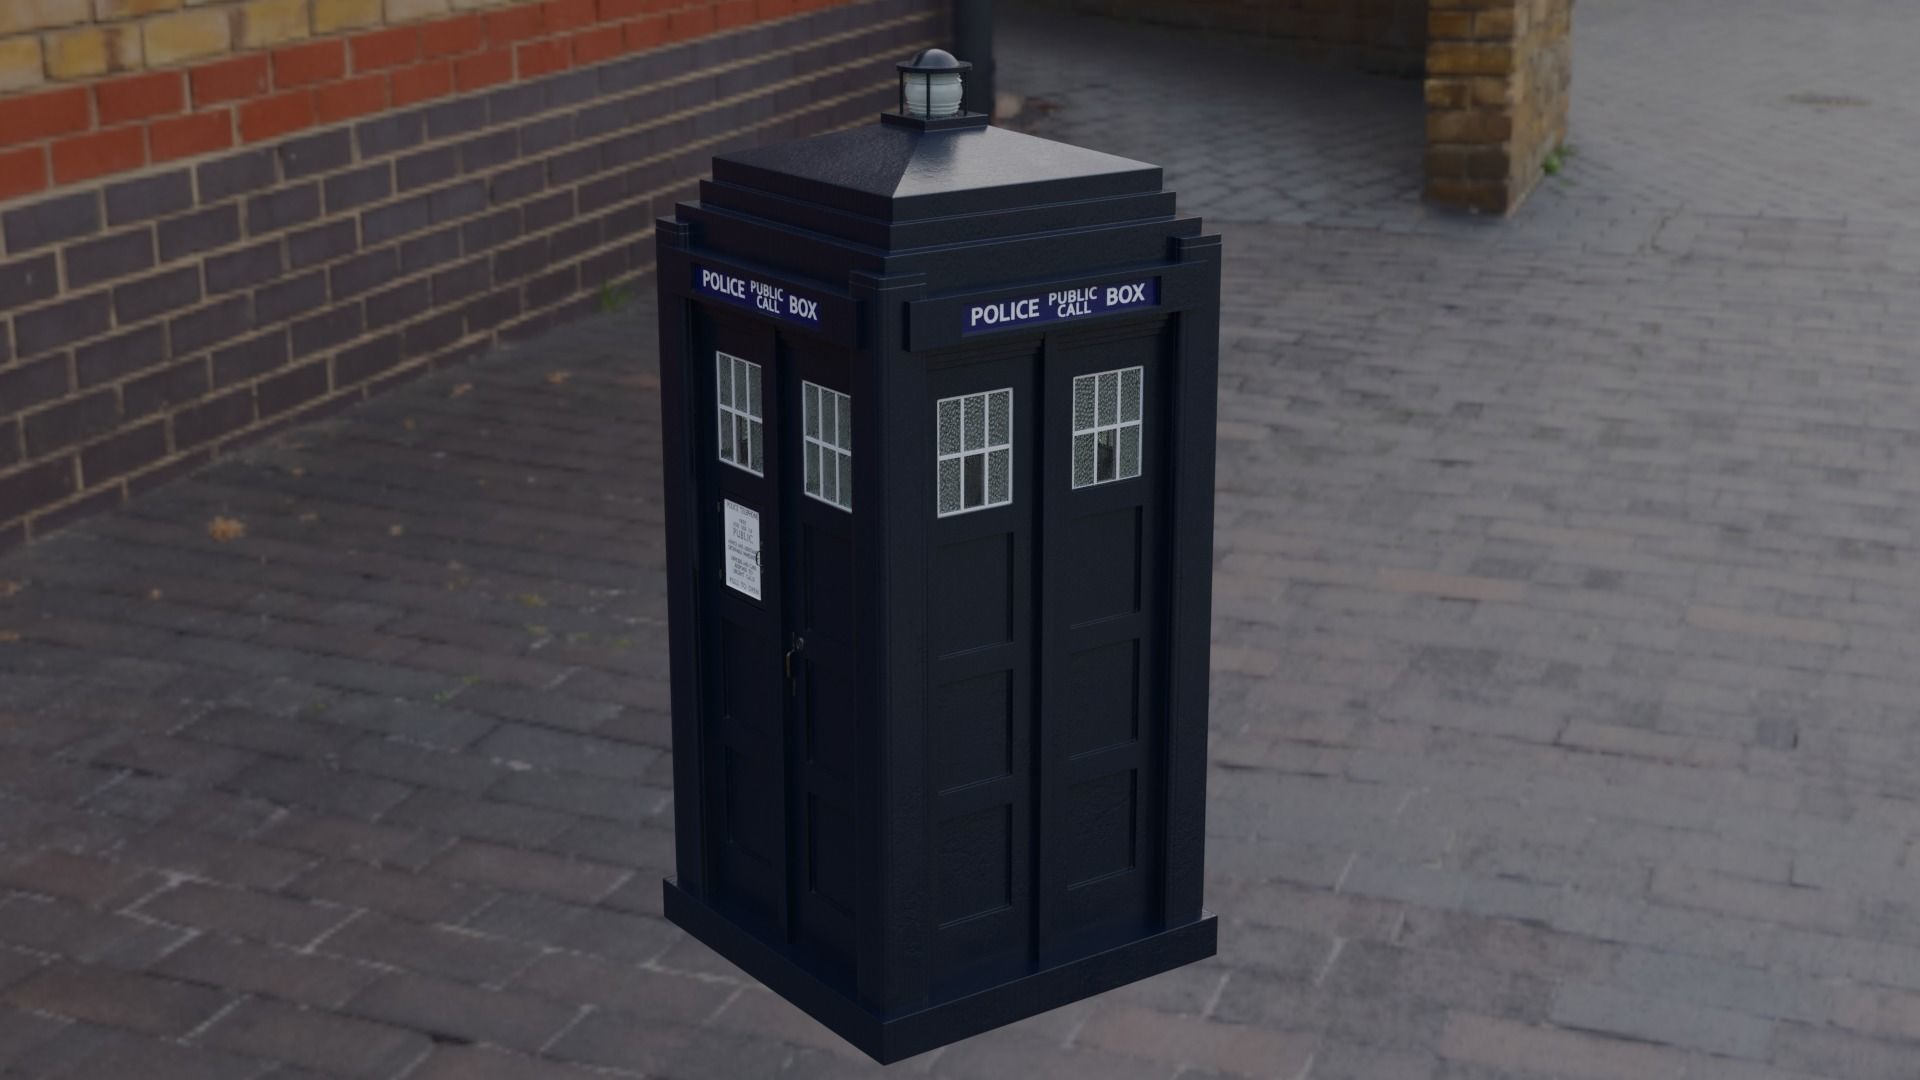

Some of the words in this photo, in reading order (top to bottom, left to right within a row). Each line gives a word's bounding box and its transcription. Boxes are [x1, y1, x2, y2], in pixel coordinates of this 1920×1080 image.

[703, 269, 746, 299] POLICE
[750, 280, 784, 302] PUBLIC
[1106, 283, 1145, 306] BOX
[756, 295, 780, 314] CALL
[1048, 286, 1098, 306] PUBLIC
[789, 295, 818, 321] BOX
[971, 298, 1040, 326] POLICE
[1057, 301, 1092, 318] CALL
[732, 527, 754, 544] PUBLIC
